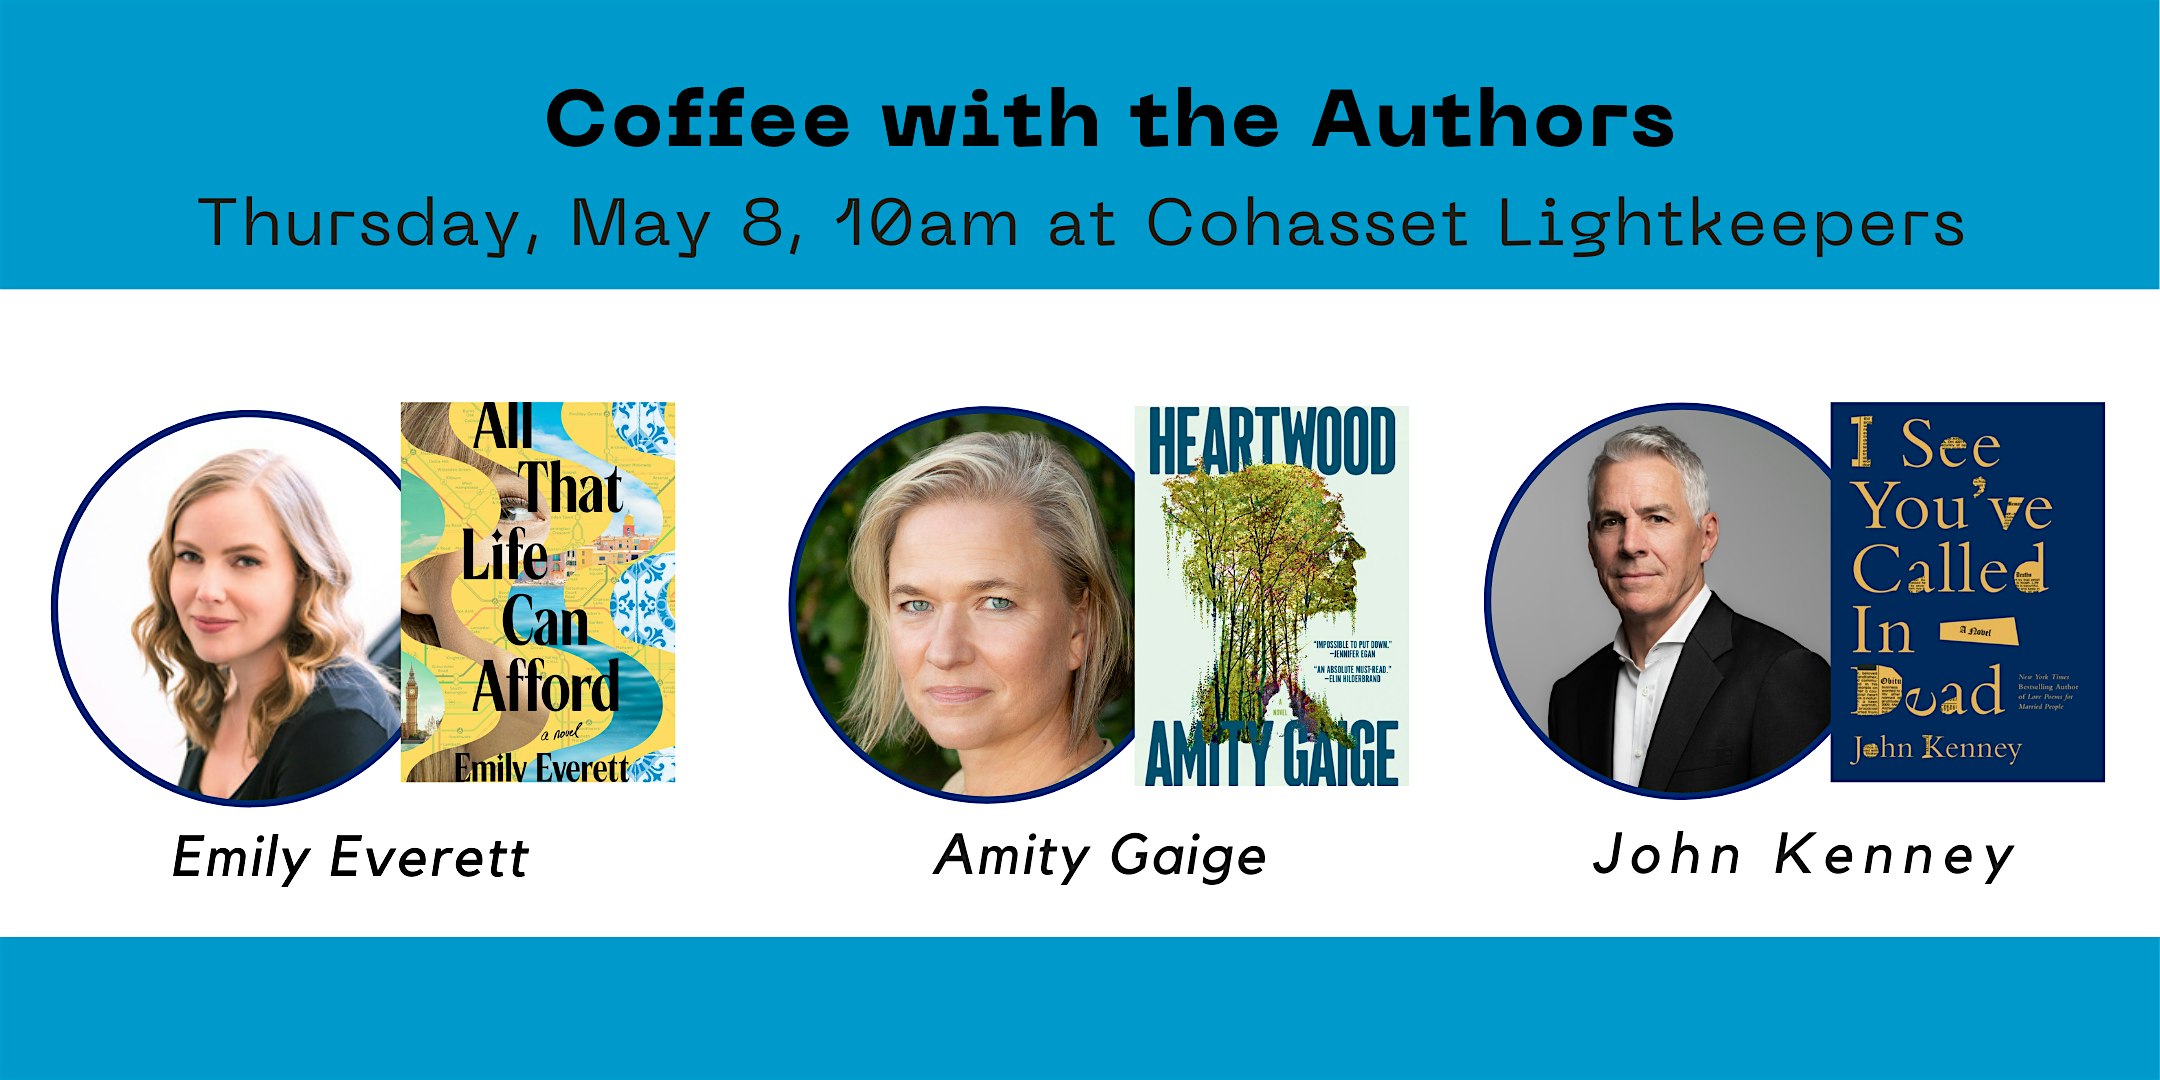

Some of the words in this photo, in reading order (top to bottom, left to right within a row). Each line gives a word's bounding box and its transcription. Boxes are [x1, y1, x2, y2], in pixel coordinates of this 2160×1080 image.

[547, 87, 849, 147] Coffee
[882, 87, 1097, 147] with
[1130, 87, 1278, 147] the
[1312, 87, 1675, 147] Authors
[198, 196, 537, 258] Thursday,
[574, 198, 710, 258] May
[743, 198, 800, 256] 8,
[836, 197, 1016, 247] 10am
[1050, 202, 1115, 247] at
[1149, 196, 1467, 247] Cohasset
[1502, 196, 1965, 258] Lightkeepers
[473, 402, 532, 449] All
[1149, 406, 1396, 475] HEARTWOOD
[1850, 416, 1873, 468] I
[1902, 418, 2001, 468] See
[517, 460, 624, 513] That
[1849, 476, 2053, 531] You've
[463, 526, 548, 580] Life
[1852, 541, 2049, 594] Called
[502, 593, 588, 646] Can
[1350, 640, 1358, 649] TO
[1359, 640, 1369, 649] PUT
[1852, 605, 1915, 653] In
[1959, 625, 1966, 634] A
[1968, 626, 1992, 637] Novel
[1326, 665, 1354, 674] ABSOLUTE
[1342, 674, 1381, 683] HILDERBRAND
[1360, 649, 1376, 658] EGAN
[472, 658, 619, 712] Afford
[1850, 663, 2006, 717] Dead
[2018, 683, 2054, 691] Bestselling
[2044, 703, 2064, 711] People
[540, 731, 549, 741] a
[553, 722, 583, 741] novel
[1145, 720, 1274, 786] AMITY
[1283, 719, 1399, 787] GAIGE
[1849, 734, 1914, 765] John
[1921, 734, 2023, 765] Kenney
[536, 752, 630, 782] Everett
[172, 834, 312, 888] Emily
[331, 834, 530, 878] Everett
[932, 832, 1091, 886] Amity
[1112, 832, 1266, 886] Gaige
[1592, 830, 1739, 875] John
[1775, 831, 2015, 885] Kenney
